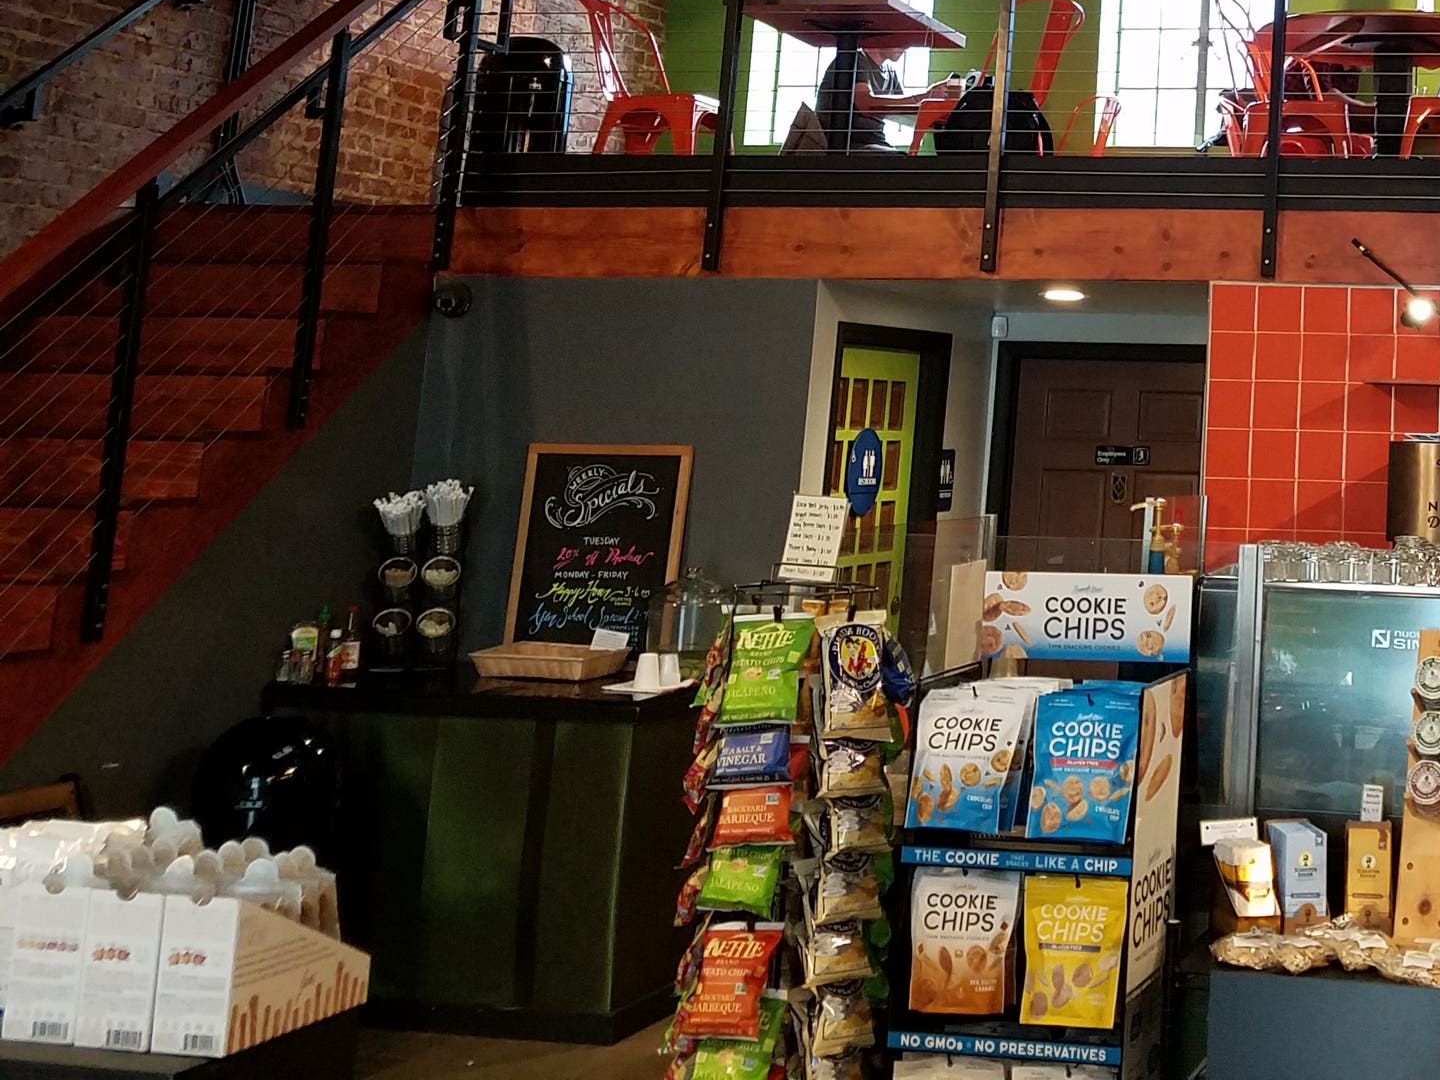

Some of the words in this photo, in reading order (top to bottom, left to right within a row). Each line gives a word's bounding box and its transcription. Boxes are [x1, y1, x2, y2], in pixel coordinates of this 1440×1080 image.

[569, 467, 605, 490] WEEKLY
[563, 470, 660, 527] Specials
[583, 536, 621, 546] TUESDAY
[556, 547, 580, 562] 20%
[585, 550, 600, 566] off
[554, 571, 590, 580] MONDAY
[598, 571, 629, 580] FRIDAY
[1045, 596, 1127, 615] COOKIE
[1043, 616, 1125, 641] CHIPS
[763, 655, 785, 666] CHIPS
[934, 716, 1003, 732] COOKIE
[1052, 721, 1124, 739] COOKIE
[928, 731, 998, 752] CHIPS
[1049, 737, 1121, 760] CHIPS
[716, 753, 766, 768] VINEGAR
[719, 812, 776, 826] BARBEQUE
[914, 848, 941, 863] THE
[945, 851, 1000, 866] COOKIE
[1035, 855, 1067, 870] LIKE
[1070, 859, 1080, 871] A
[1084, 858, 1119, 873] CHIP
[1134, 857, 1172, 908] COOKIE
[926, 892, 999, 911] COOKIE
[923, 910, 996, 933] CHIPS
[1040, 903, 1110, 922] COOKIE
[1132, 893, 1172, 949] CHIPS
[1036, 920, 1105, 943] CHIPS
[899, 1034, 921, 1048] NO
[924, 1036, 964, 1052] GMOs
[975, 1040, 995, 1054] NO
[999, 1042, 1107, 1062] PRESERVATIVES
